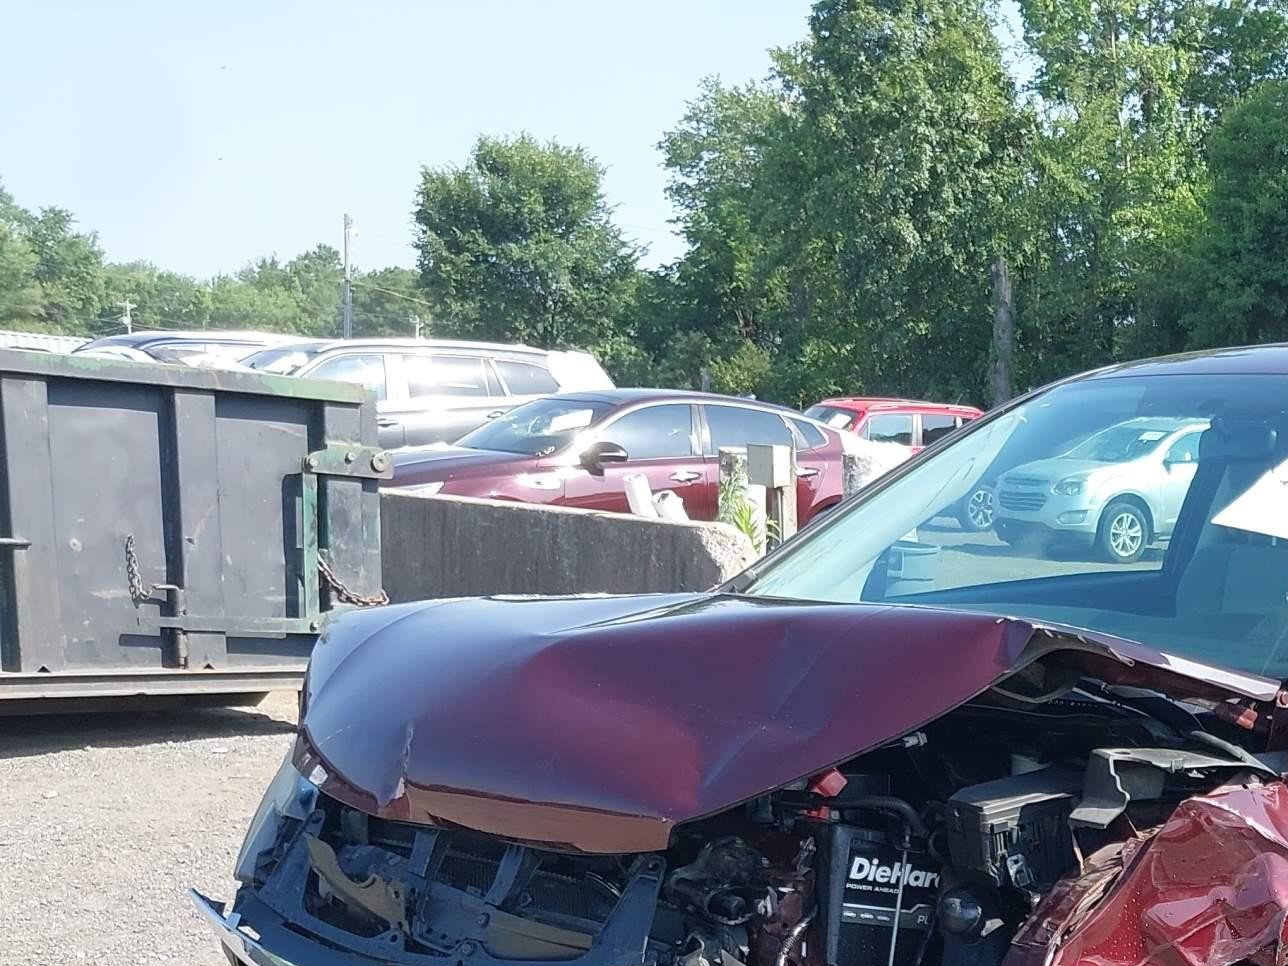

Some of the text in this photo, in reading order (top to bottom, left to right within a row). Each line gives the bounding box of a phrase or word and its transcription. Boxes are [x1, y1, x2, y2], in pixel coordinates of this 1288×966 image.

[849, 856, 940, 888] DieHar
[845, 882, 901, 895] POWER AHEAD
